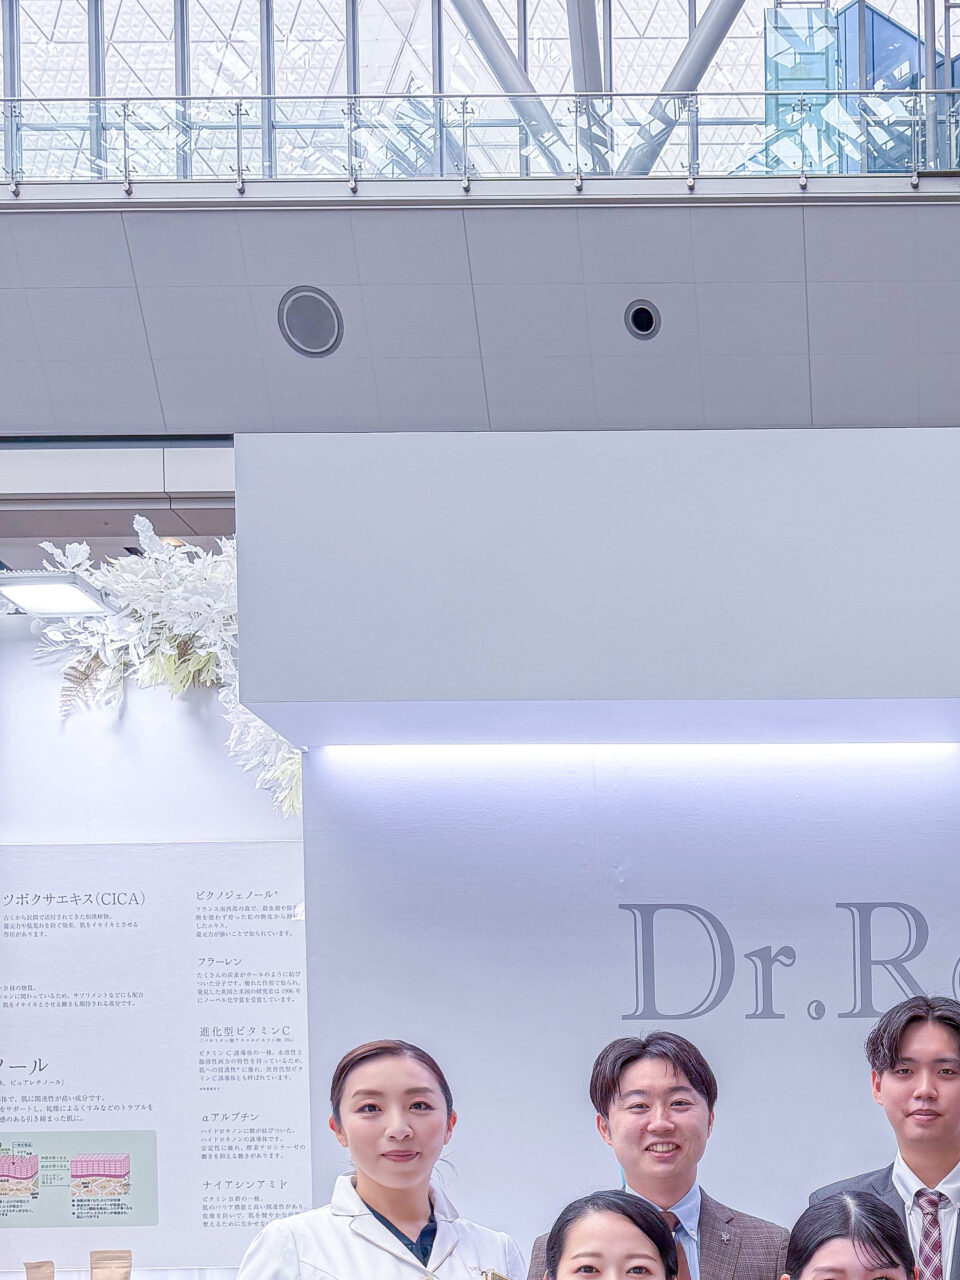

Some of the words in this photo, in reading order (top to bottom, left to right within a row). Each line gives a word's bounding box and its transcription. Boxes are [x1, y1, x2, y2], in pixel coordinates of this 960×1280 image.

[3, 891, 146, 906] ツボクサエキス(CICA)
[198, 957, 243, 966] フラーレン
[199, 1026, 291, 1037] 進化型ビタミンC
[202, 1180, 288, 1190] ナイアシンアミド
